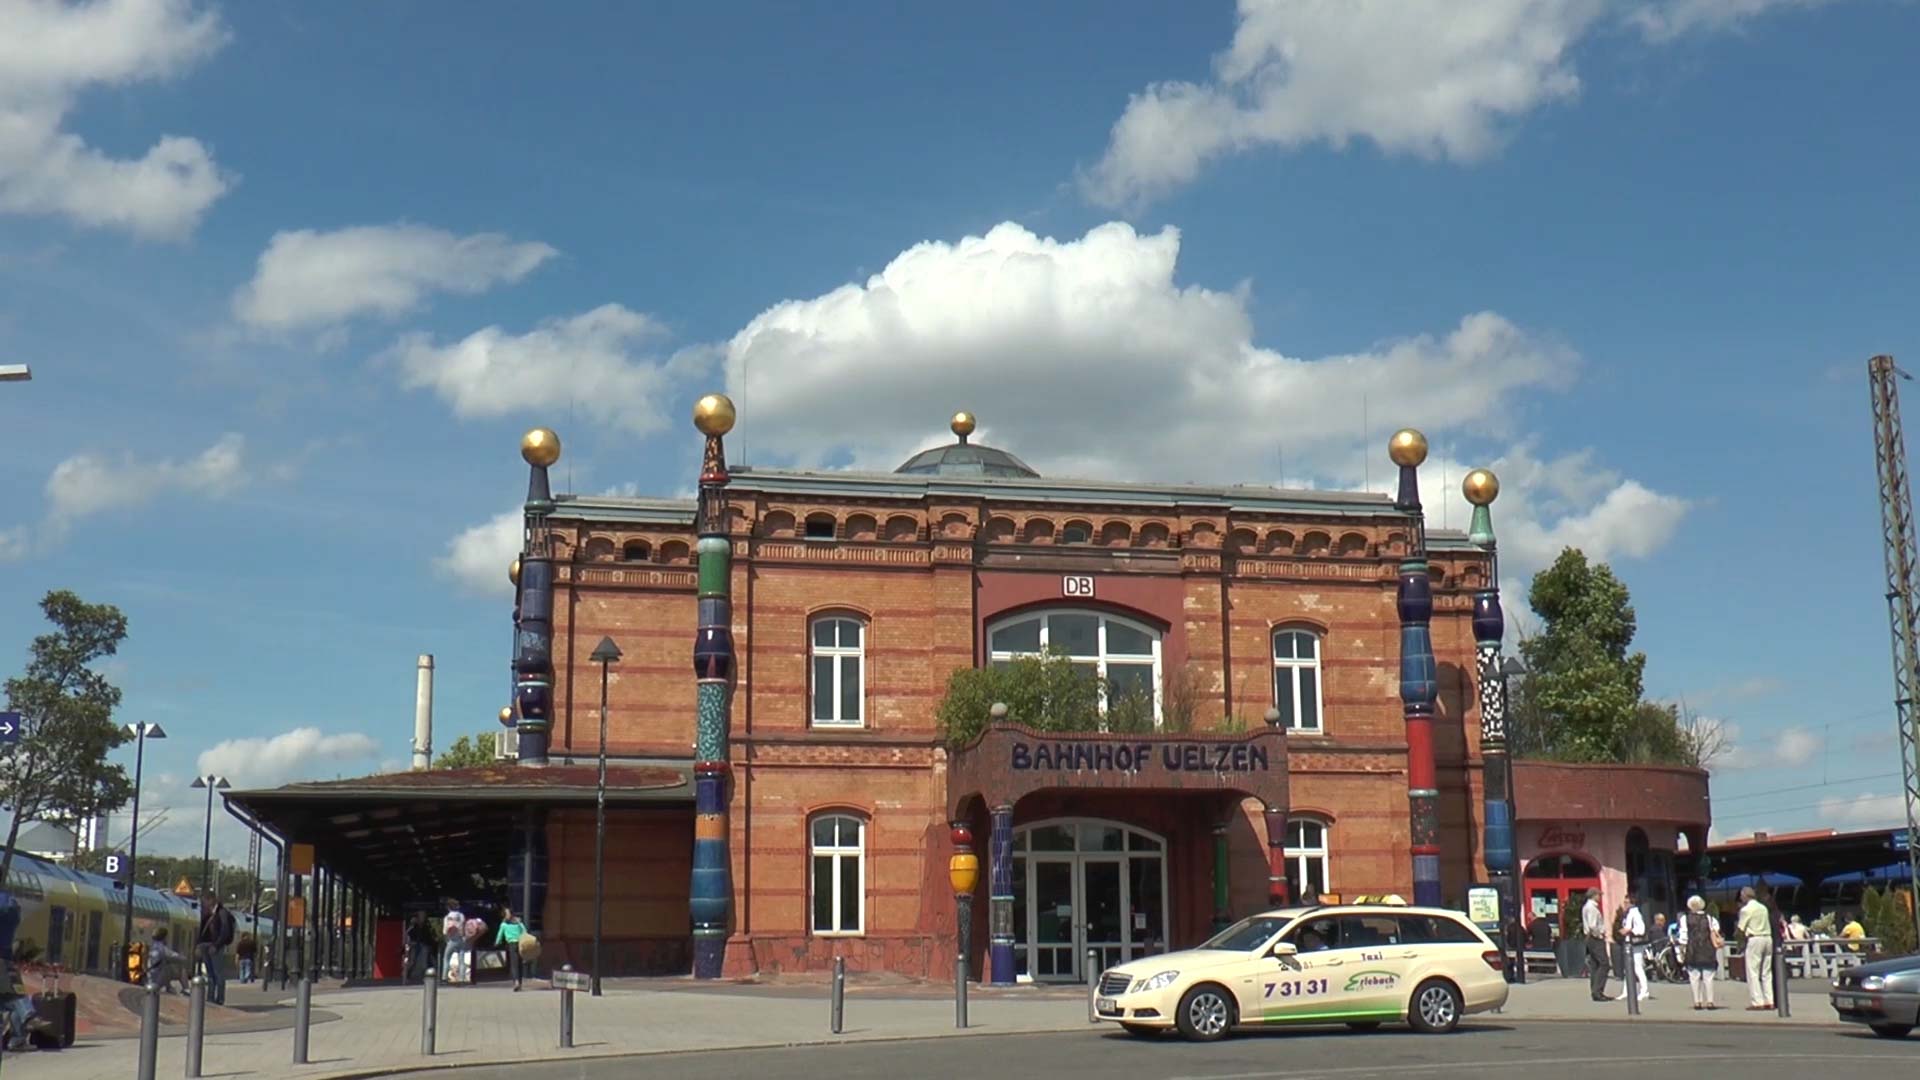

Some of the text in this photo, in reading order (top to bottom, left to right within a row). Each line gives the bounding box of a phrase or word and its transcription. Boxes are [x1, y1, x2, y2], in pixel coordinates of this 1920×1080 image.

[1066, 577, 1091, 594] DB
[1012, 743, 1268, 771] BAHNHOF UELZEN
[106, 856, 119, 873] B
[1361, 951, 1383, 961] Taxi
[1264, 979, 1328, 998] 7 31 31
[1344, 971, 1399, 991] Erlebach
